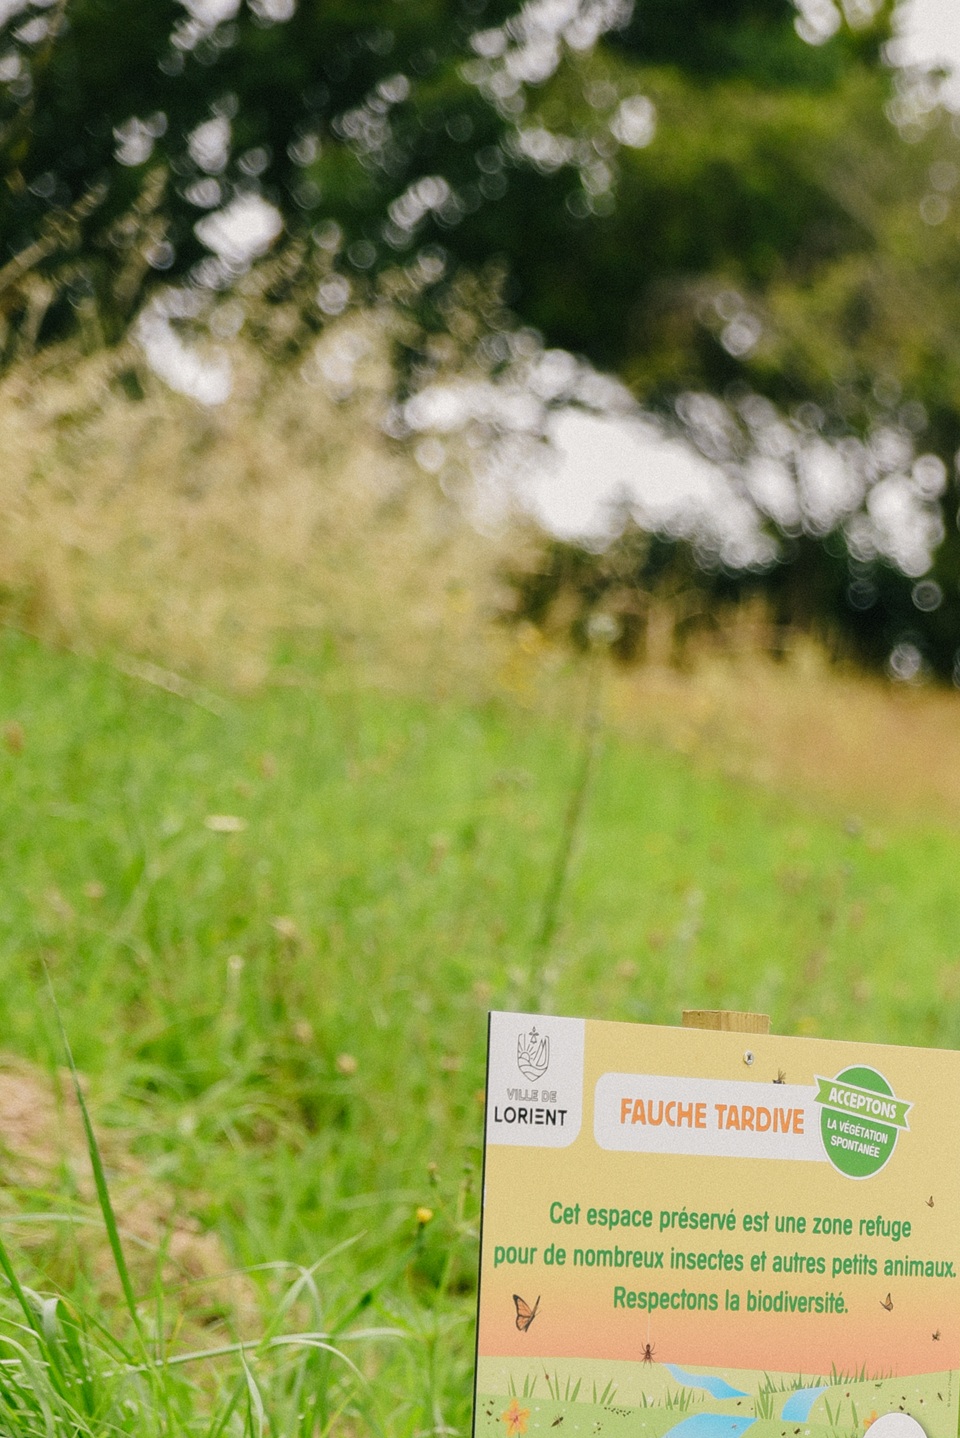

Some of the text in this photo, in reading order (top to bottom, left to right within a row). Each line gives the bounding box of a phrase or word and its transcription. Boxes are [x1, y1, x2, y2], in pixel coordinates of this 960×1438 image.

[507, 1088, 557, 1103] VILLE DE
[828, 1087, 897, 1119] ACCEPTONS
[494, 1106, 567, 1126] LORIENT
[620, 1098, 804, 1134] FAUCHE TARDIVE
[827, 1118, 888, 1144] LA VÉGÉTATION
[830, 1135, 880, 1158] SPONTANÉE
[550, 1201, 912, 1242] Cet espace préservé est une zone refuge
[494, 1243, 957, 1279] pour de nombreux insectes et autres petits animaux.
[613, 1286, 848, 1313] Respectons la biodiversité.
